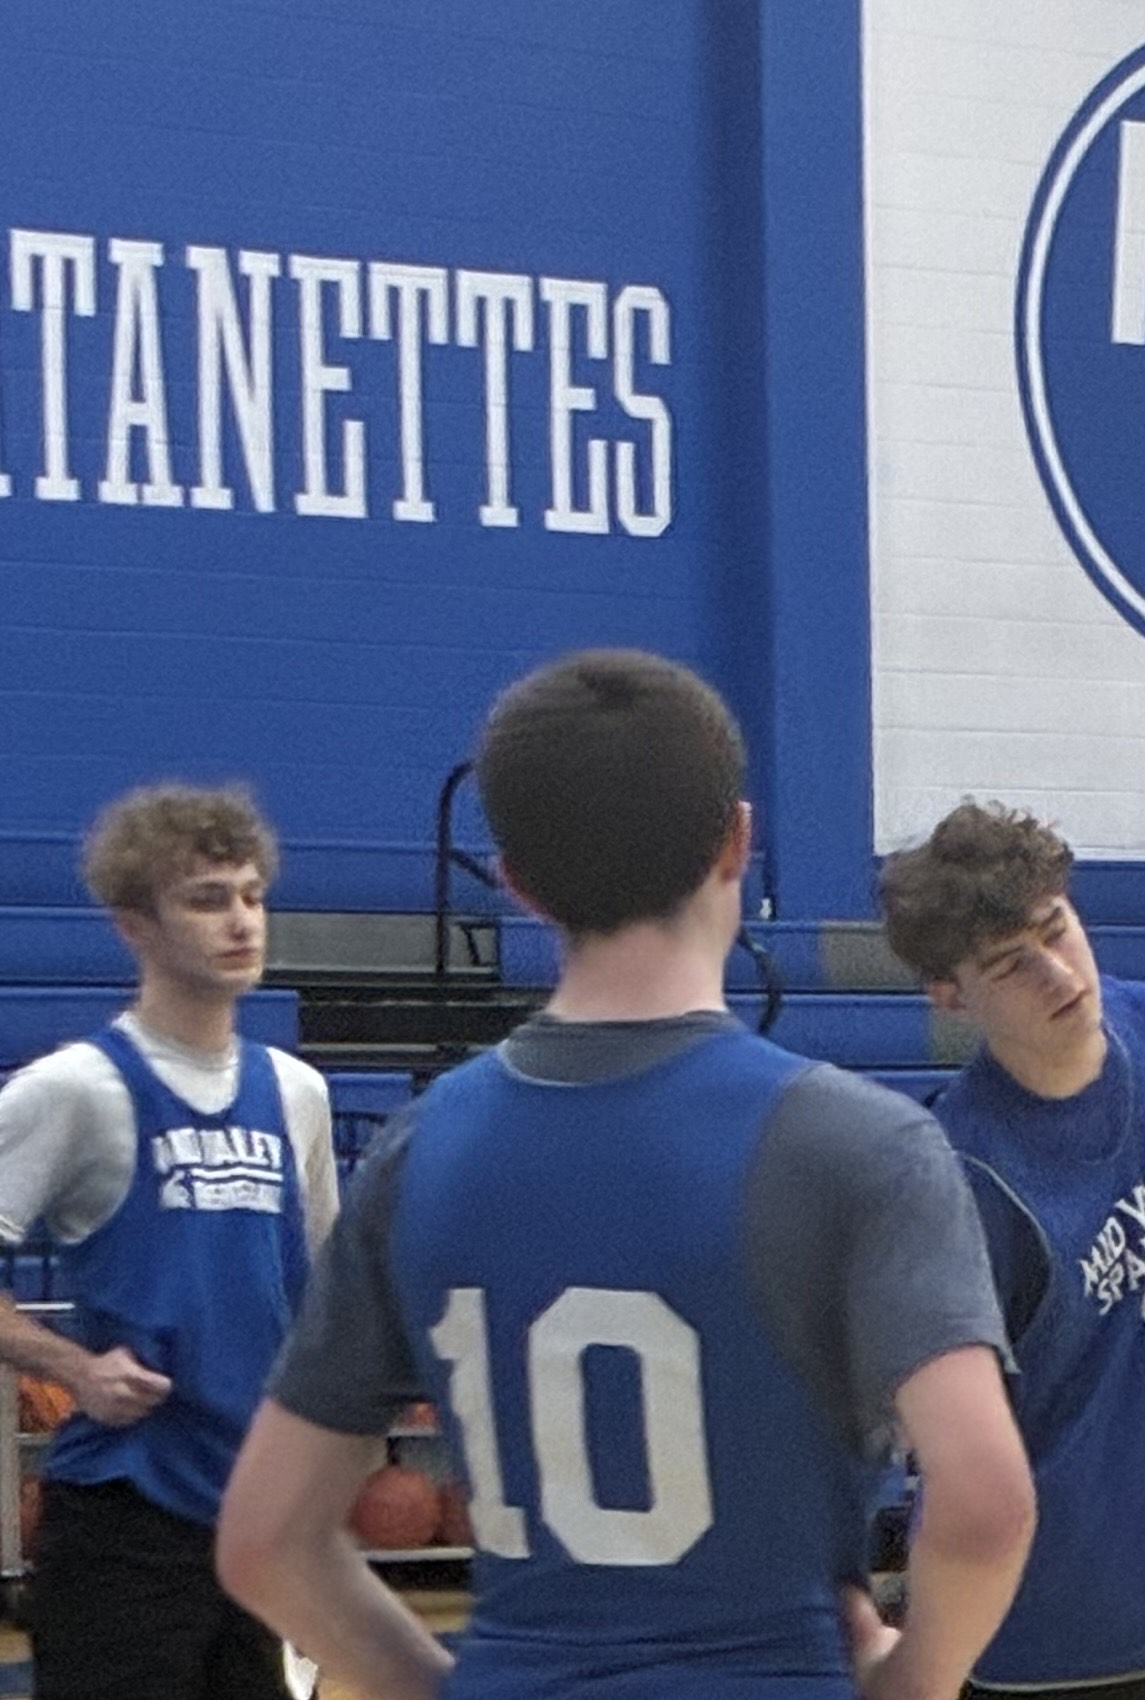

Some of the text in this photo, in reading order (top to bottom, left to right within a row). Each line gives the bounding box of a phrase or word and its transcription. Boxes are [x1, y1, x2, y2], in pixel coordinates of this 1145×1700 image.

[0, 227, 674, 538] TANETTES
[1078, 1216, 1126, 1298] MID
[427, 1286, 715, 1567] 10
